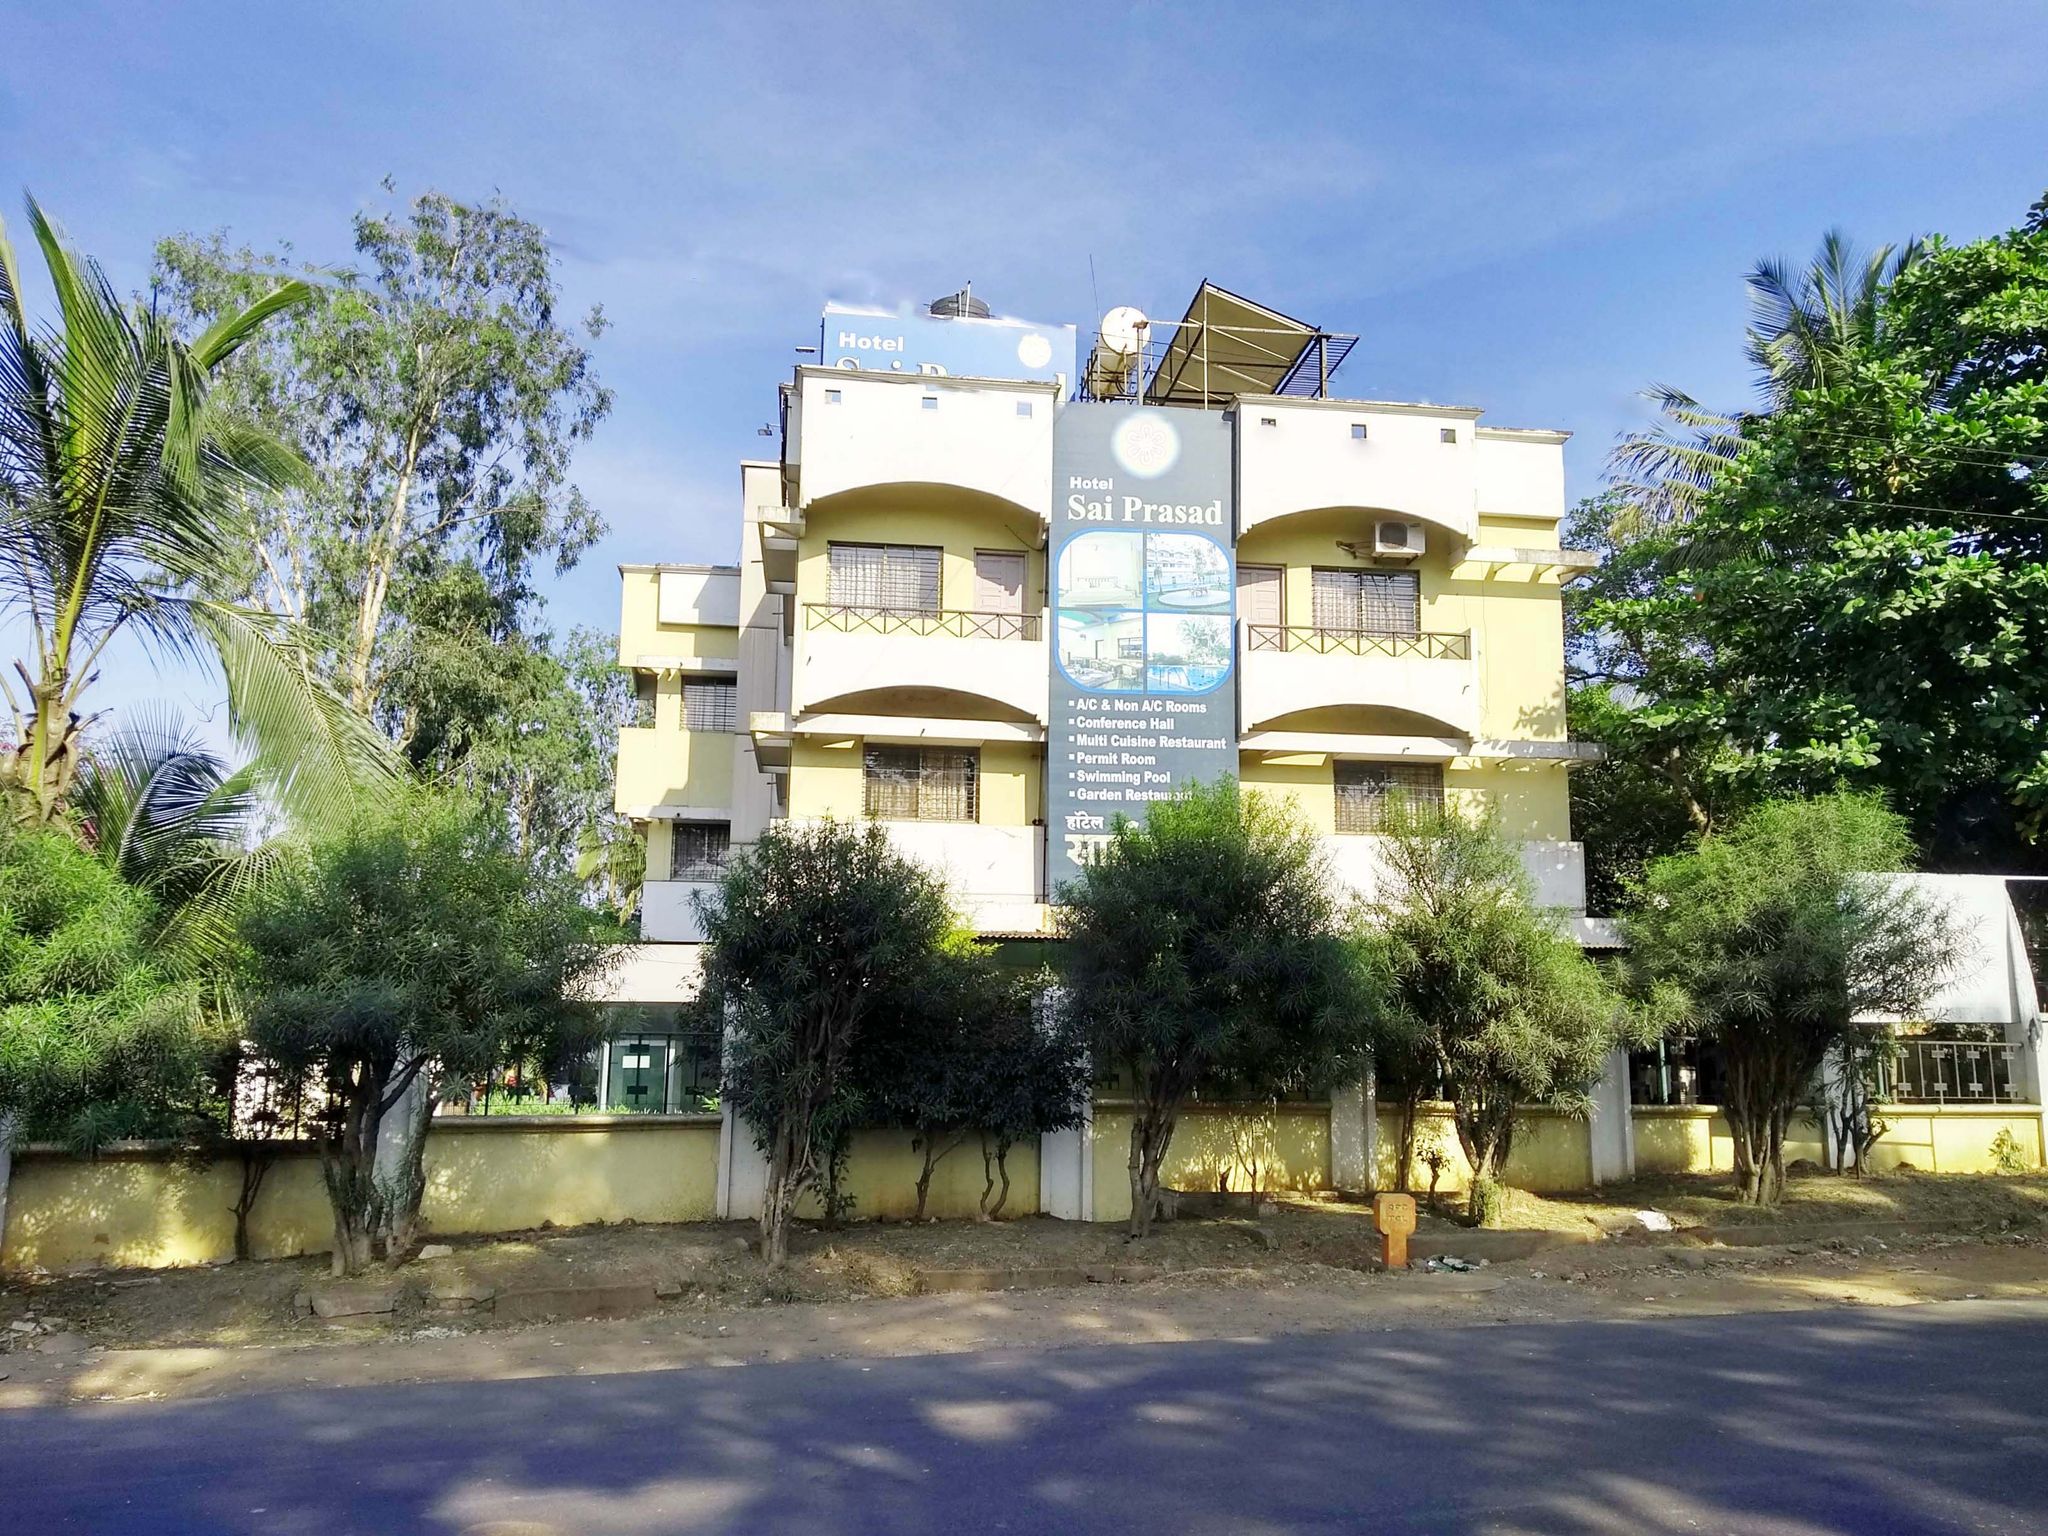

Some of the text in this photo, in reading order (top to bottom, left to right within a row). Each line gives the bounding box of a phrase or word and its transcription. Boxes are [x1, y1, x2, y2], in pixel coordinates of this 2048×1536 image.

[839, 331, 904, 352] Hotel
[1069, 476, 1113, 490] Hotel
[1067, 494, 1223, 526] Sai Prasad
[1076, 698, 1207, 713] A/C & Non A/C Rooms
[1076, 716, 1175, 730] Conference Hall
[1076, 734, 1227, 749] Multi Cuisine Restaurant
[1076, 752, 1156, 765] Permit Room
[1076, 770, 1171, 785] Swimming Pool
[1076, 788, 1122, 800] Garden
